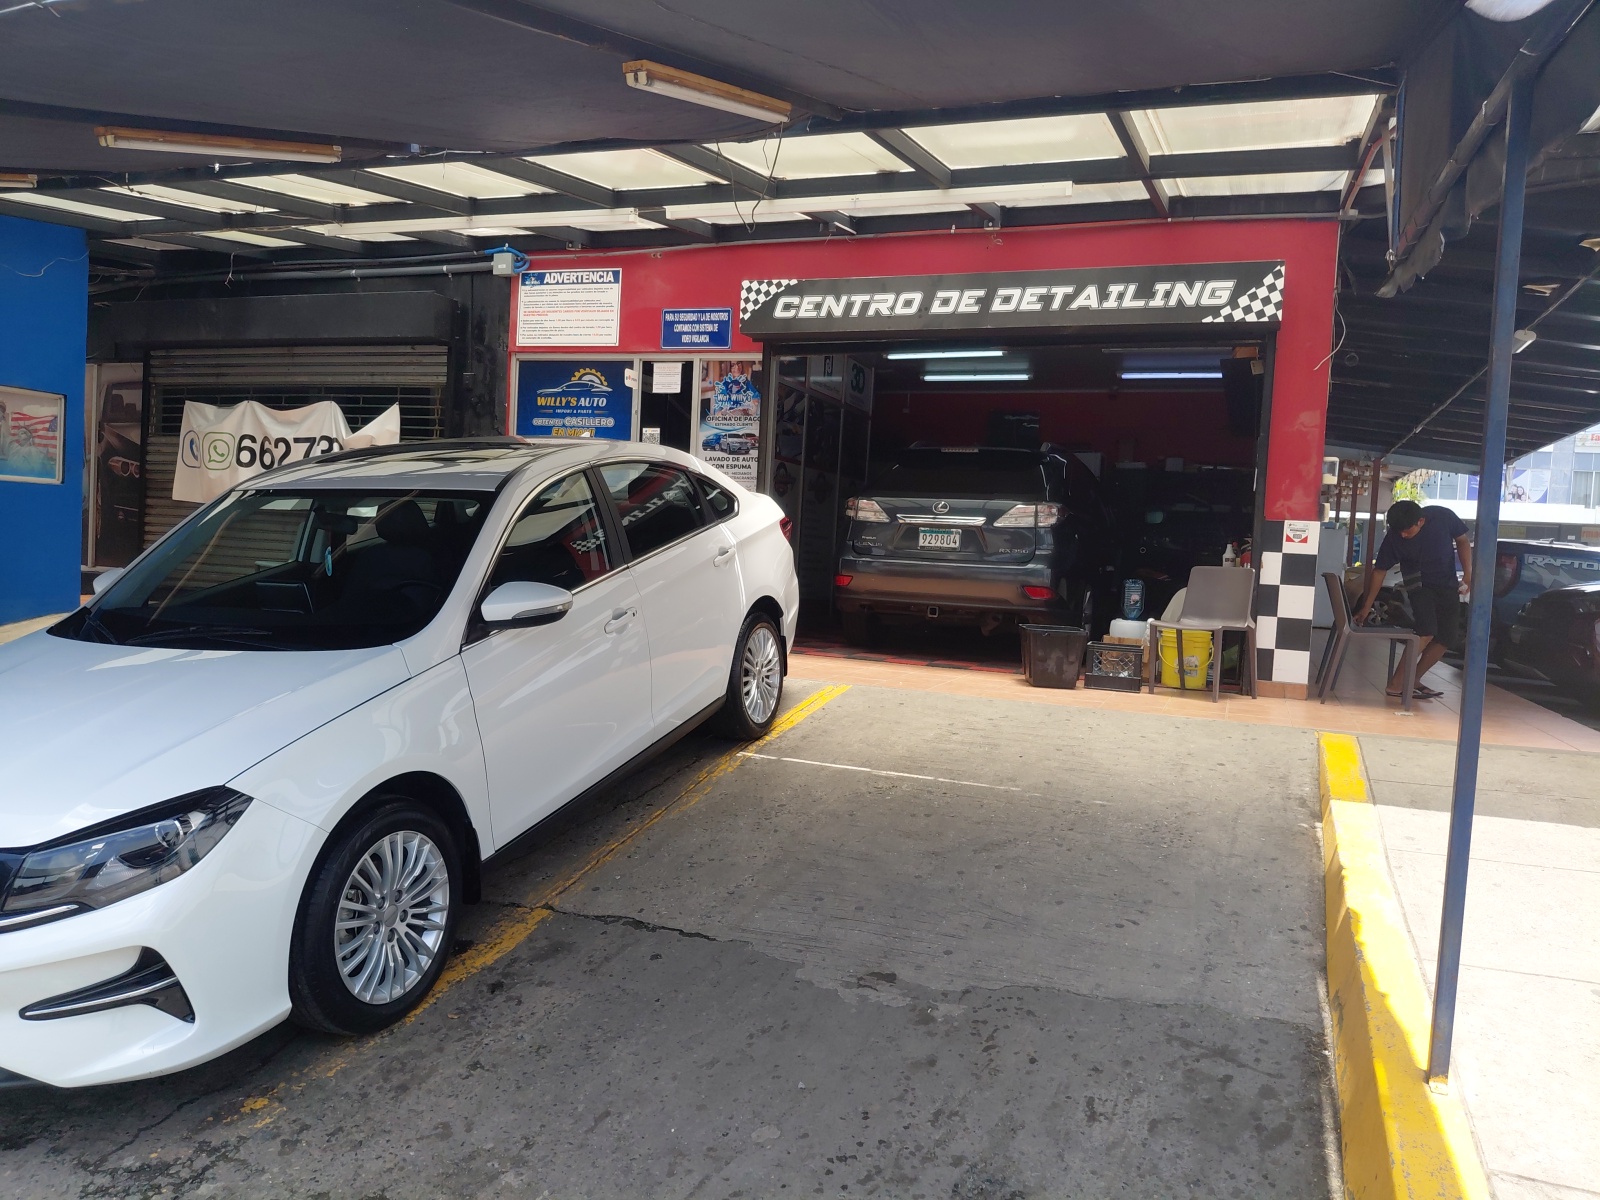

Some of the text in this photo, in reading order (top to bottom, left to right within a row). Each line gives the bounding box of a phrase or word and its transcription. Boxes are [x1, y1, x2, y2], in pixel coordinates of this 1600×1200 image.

[543, 271, 615, 284] ADVERTENCIA
[773, 279, 1237, 319] CENTRO DE DETAILING
[665, 313, 674, 321] PARA
[680, 313, 698, 321] SEGURIDAD
[710, 312, 729, 320] NOSOTROS
[673, 323, 692, 332] CONTAMOS
[691, 323, 699, 332] CON
[699, 323, 714, 332] SISTEMA
[681, 334, 710, 343] VIDEO VIGILANCIA
[537, 396, 607, 407] WILLY'S AUTO
[564, 416, 615, 427] CASILLERO
[921, 533, 958, 546] 929804
[1527, 556, 1600, 571] RAPTO
